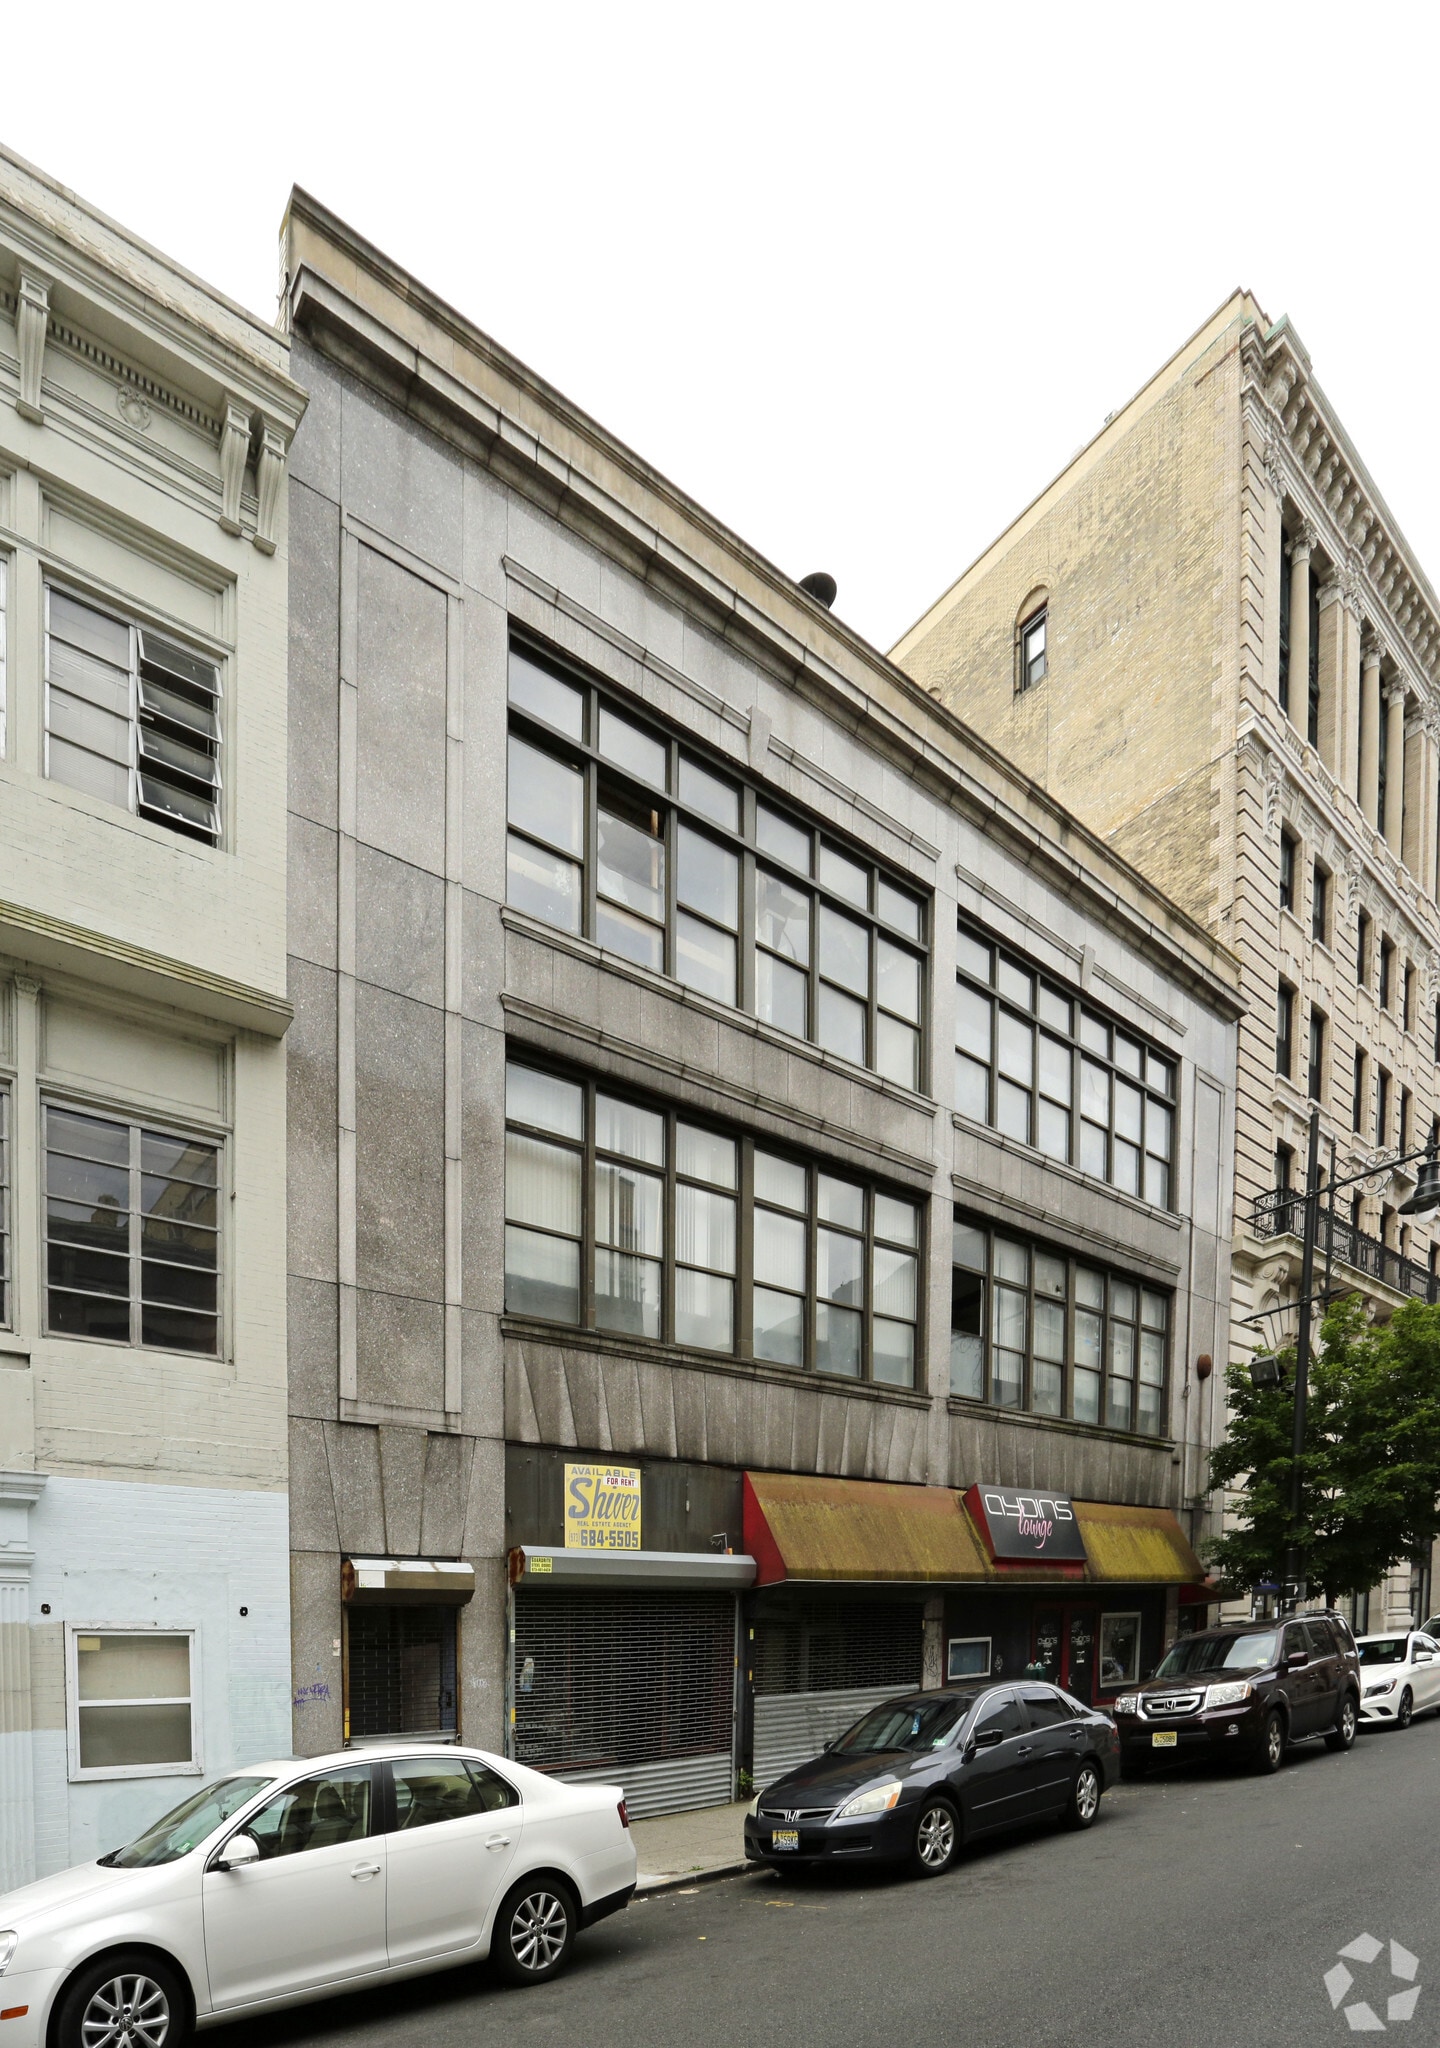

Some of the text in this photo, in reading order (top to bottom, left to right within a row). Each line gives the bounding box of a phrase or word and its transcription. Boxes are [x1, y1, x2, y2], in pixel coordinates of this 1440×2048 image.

[571, 1466, 636, 1479] AVAILABLE
[606, 1477, 635, 1487] FOR RENT
[568, 1477, 640, 1521] Shiver
